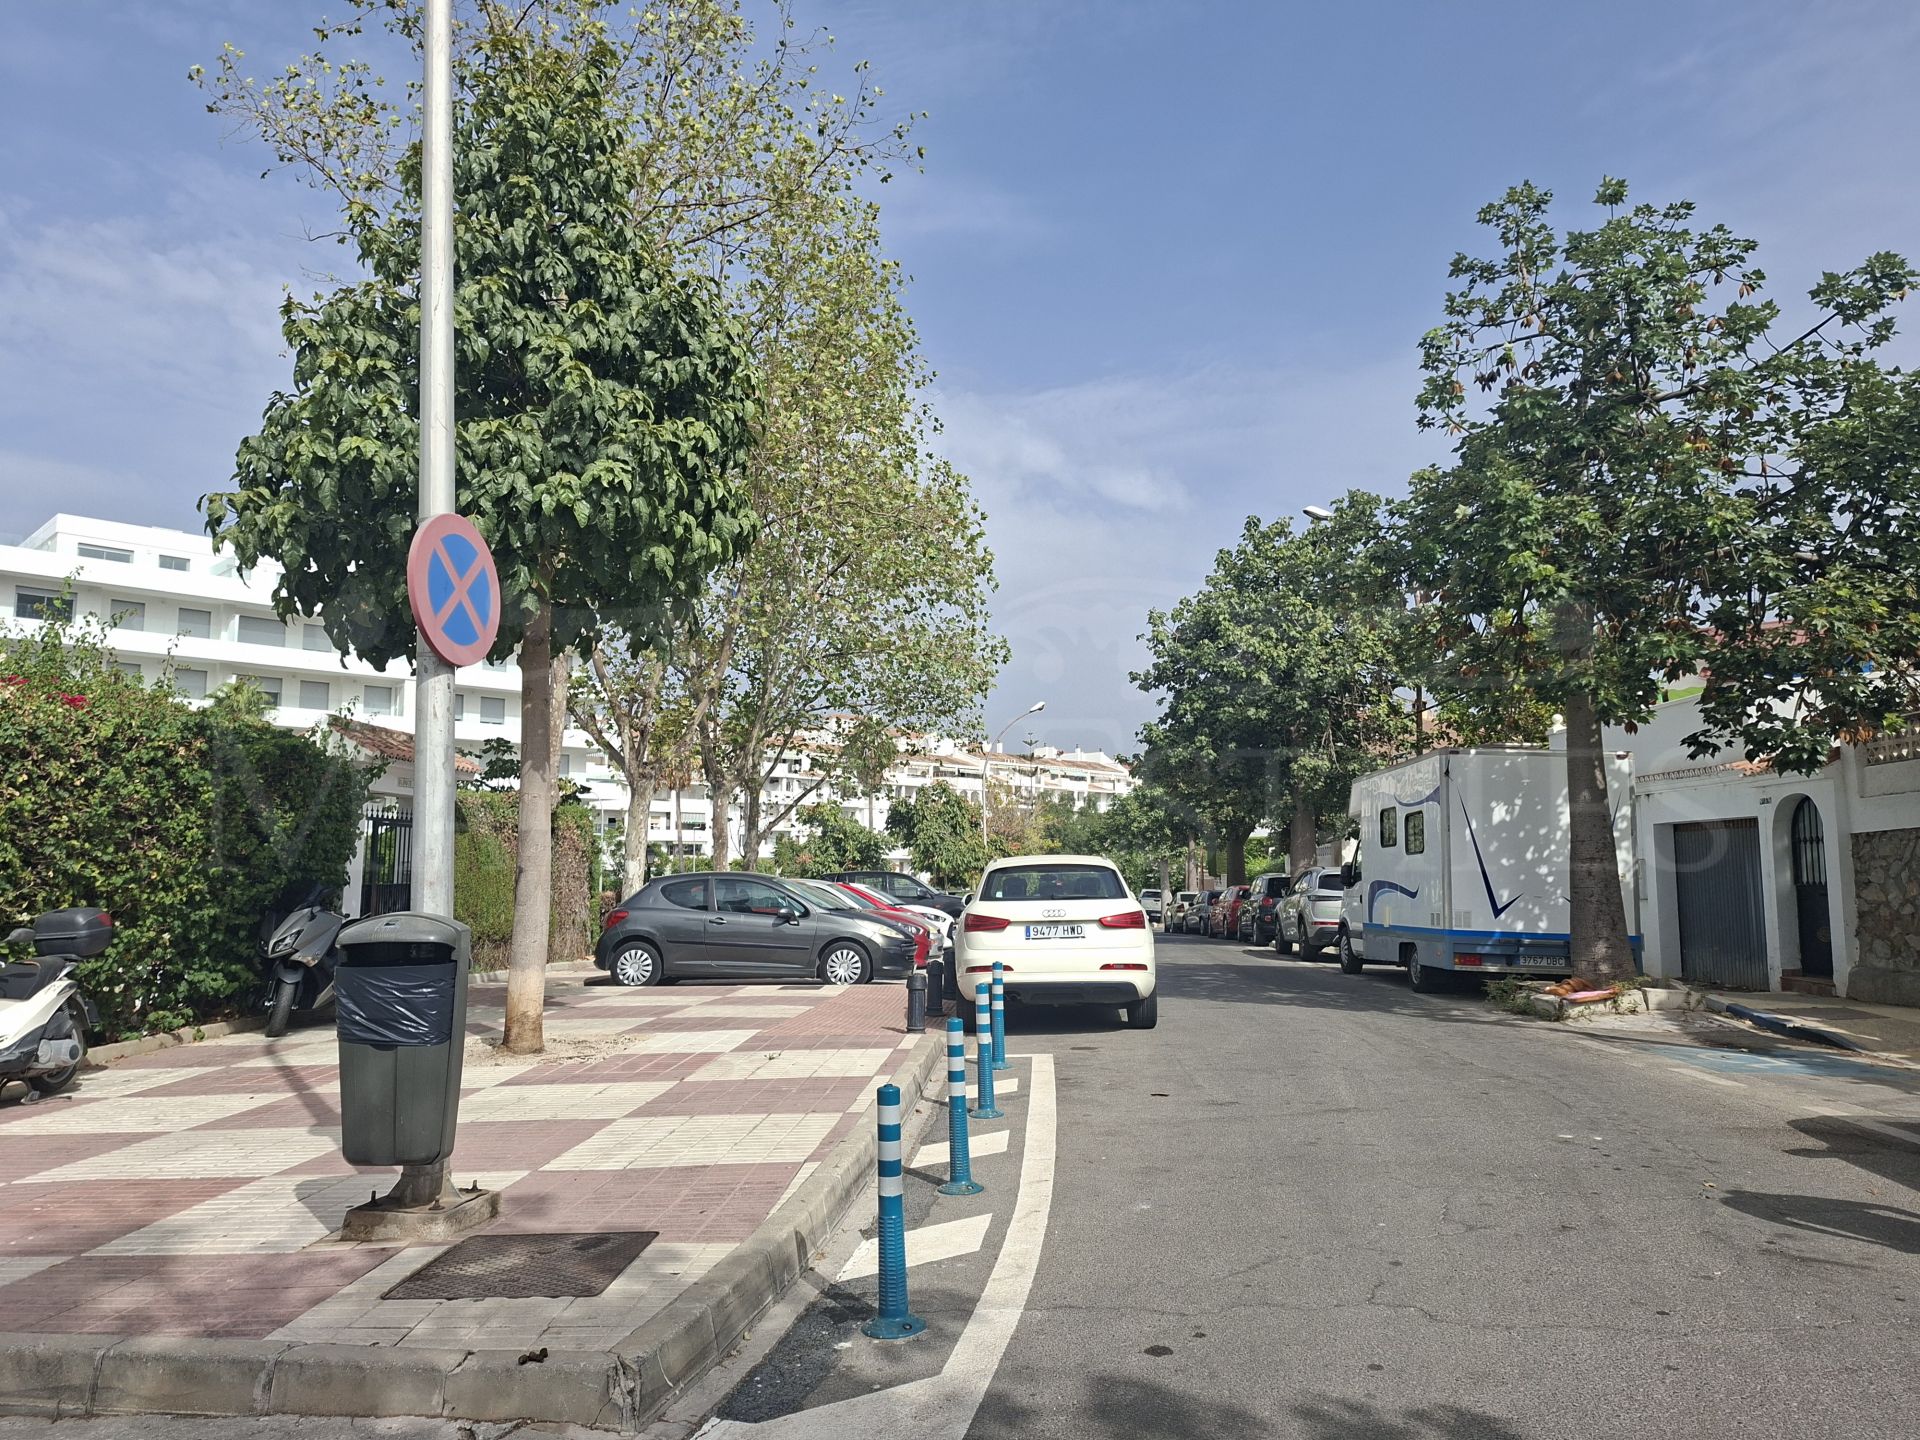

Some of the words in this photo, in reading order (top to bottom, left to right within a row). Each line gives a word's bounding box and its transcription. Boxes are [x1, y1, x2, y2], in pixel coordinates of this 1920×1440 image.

[1032, 926, 1059, 937] 9477
[1062, 925, 1083, 936] HWD
[1520, 956, 1544, 965] 3767
[1546, 957, 1564, 966] DBC
